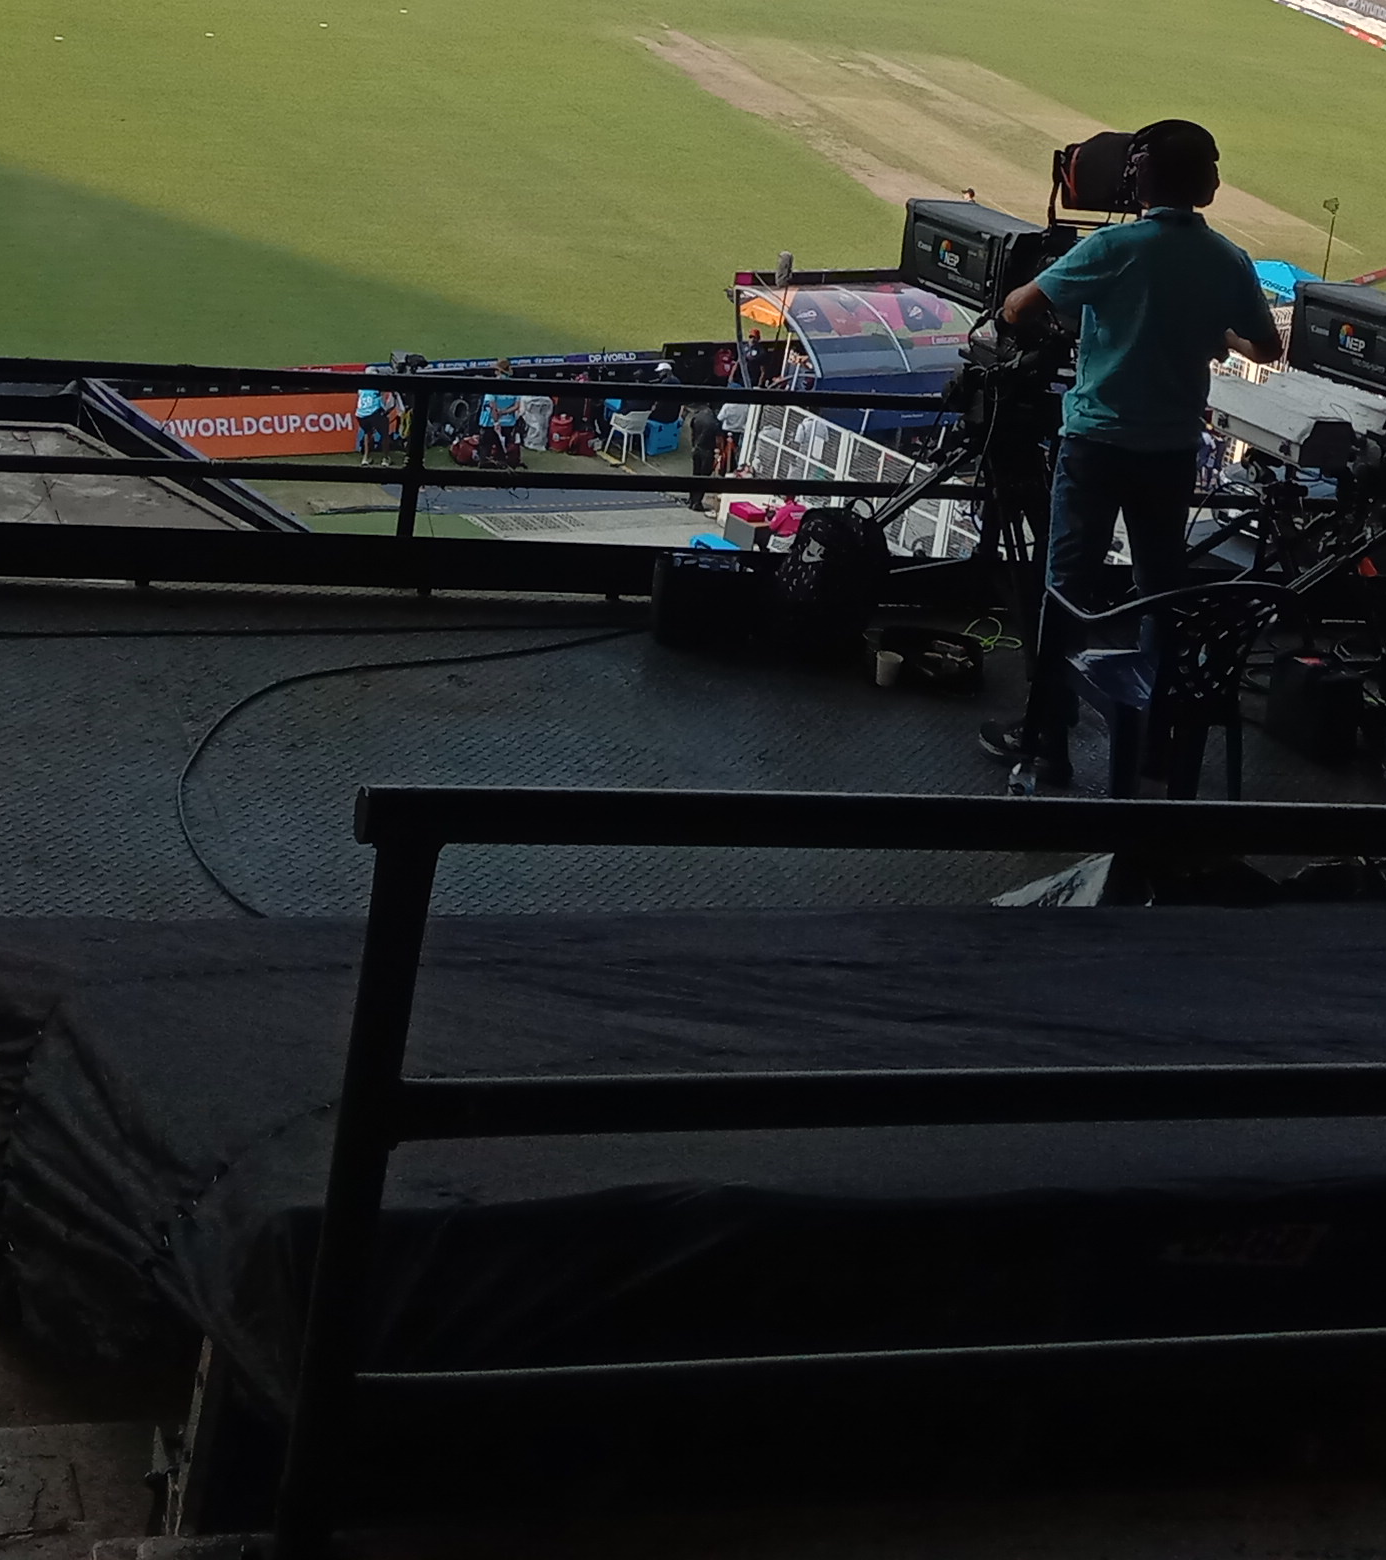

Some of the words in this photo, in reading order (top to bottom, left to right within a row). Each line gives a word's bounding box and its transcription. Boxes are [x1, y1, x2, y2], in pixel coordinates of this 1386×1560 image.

[944, 251, 960, 267] NEP
[1346, 336, 1366, 352] NEP
[588, 353, 602, 363] DP
[603, 352, 637, 362] WORLD
